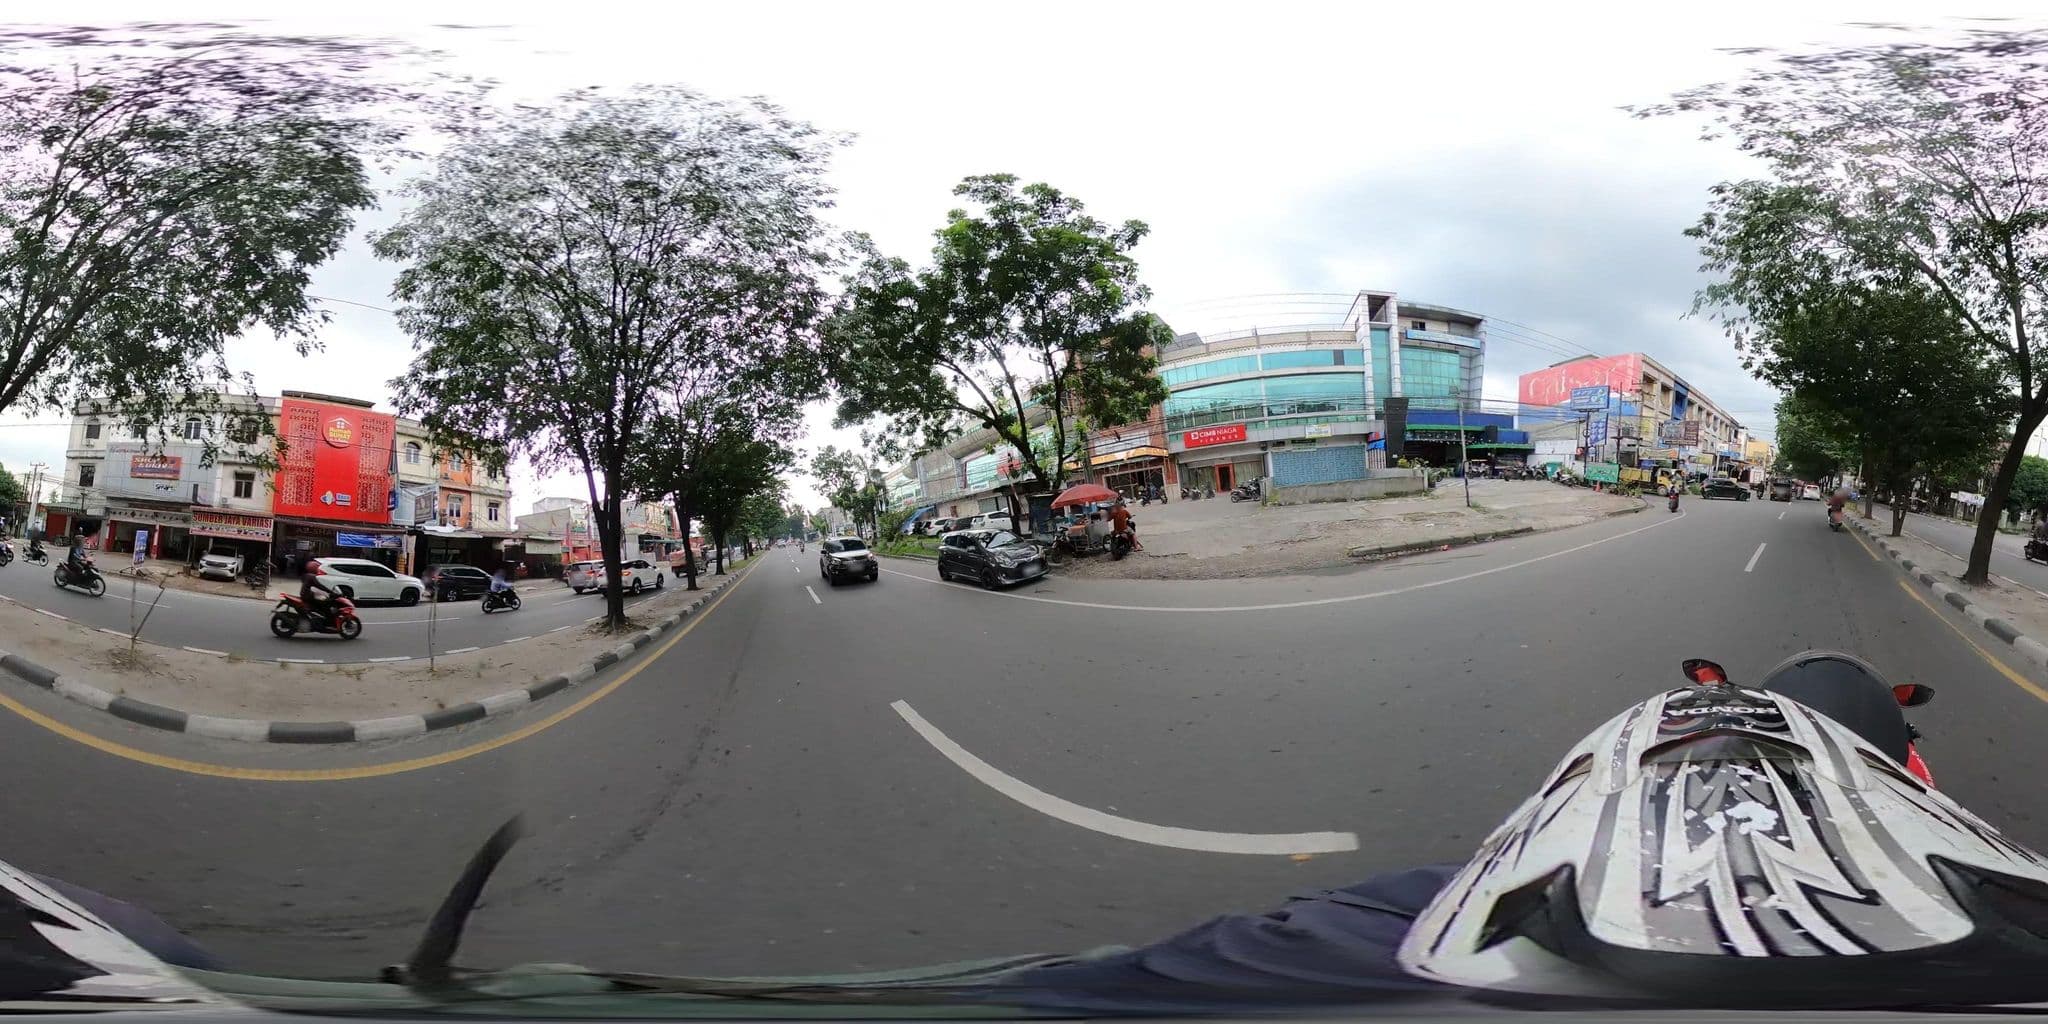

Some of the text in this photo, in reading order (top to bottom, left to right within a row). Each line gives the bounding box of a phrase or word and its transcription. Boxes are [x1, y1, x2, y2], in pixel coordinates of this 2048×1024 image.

[1200, 427, 1237, 438] CIMB NIAGA
[192, 512, 272, 529] SUMBER JAYA VARIASI
[1664, 706, 1779, 717] HONDA
